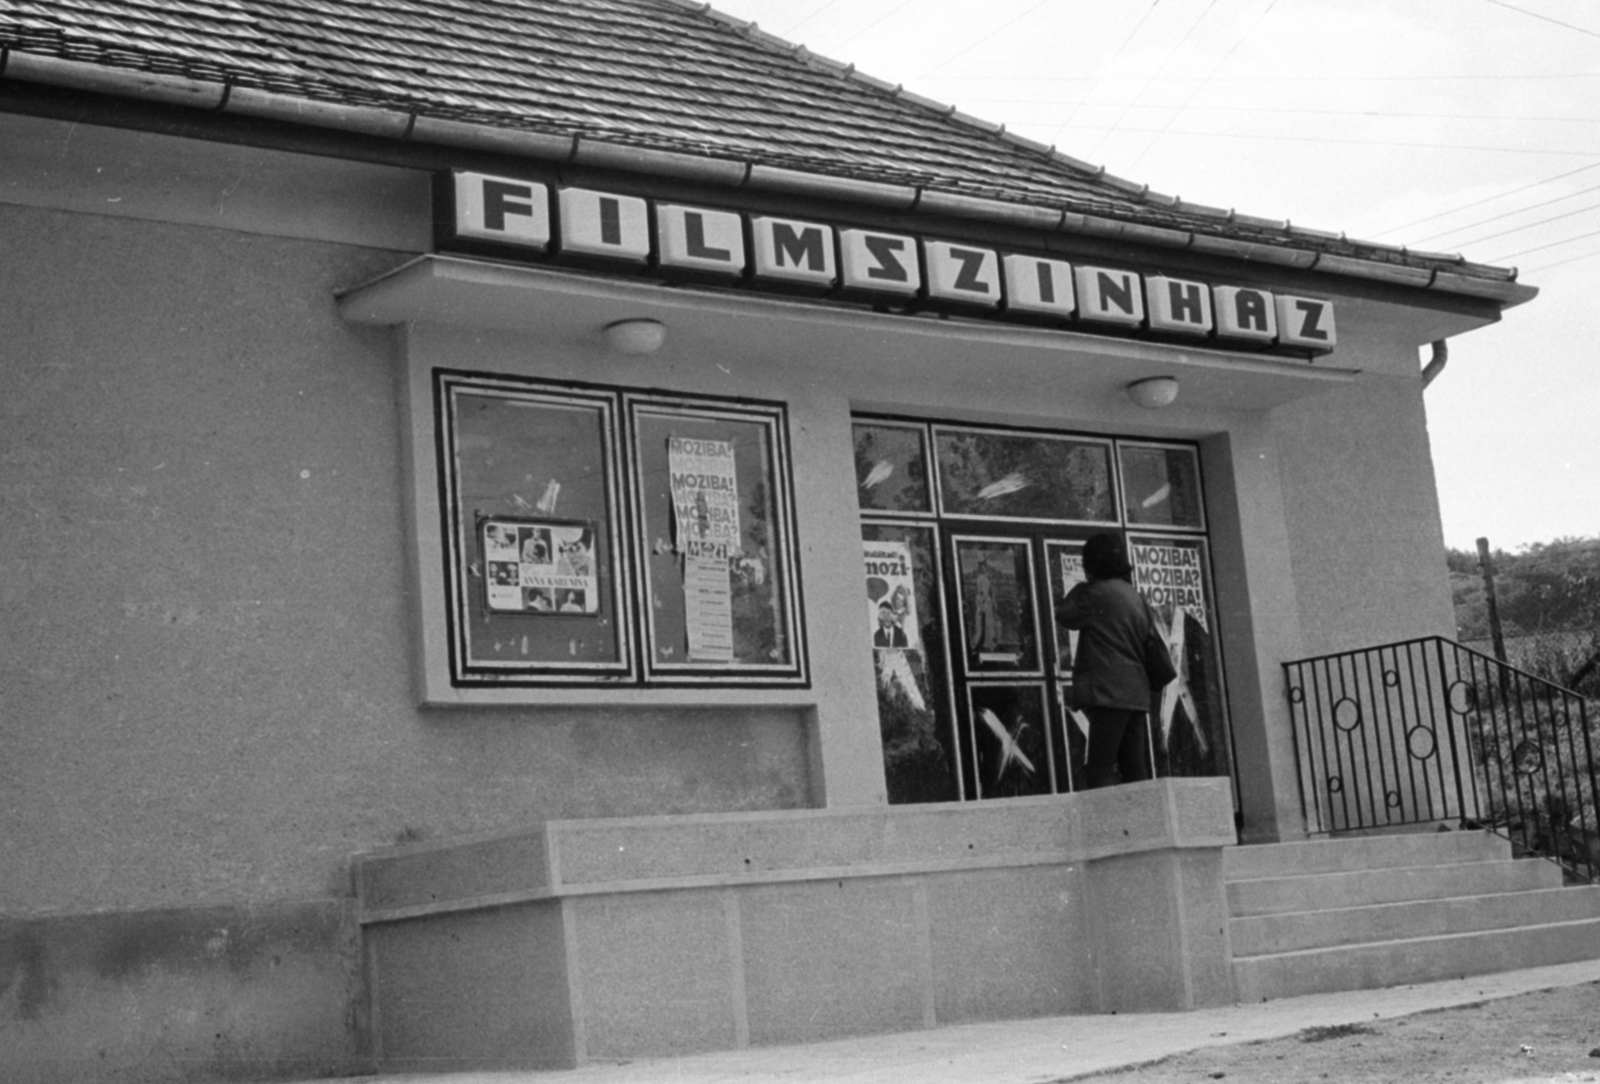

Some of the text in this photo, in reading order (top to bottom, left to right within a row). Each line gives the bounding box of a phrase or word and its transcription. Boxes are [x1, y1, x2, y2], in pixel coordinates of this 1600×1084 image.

[670, 440, 732, 459] MOZIBA!
[672, 472, 734, 492] MOZIBA!
[676, 504, 736, 524] MOIBA!
[678, 520, 739, 540] MOIBA?
[1134, 546, 1198, 568] MOZIBA!
[1137, 566, 1200, 588] MOZIBA?
